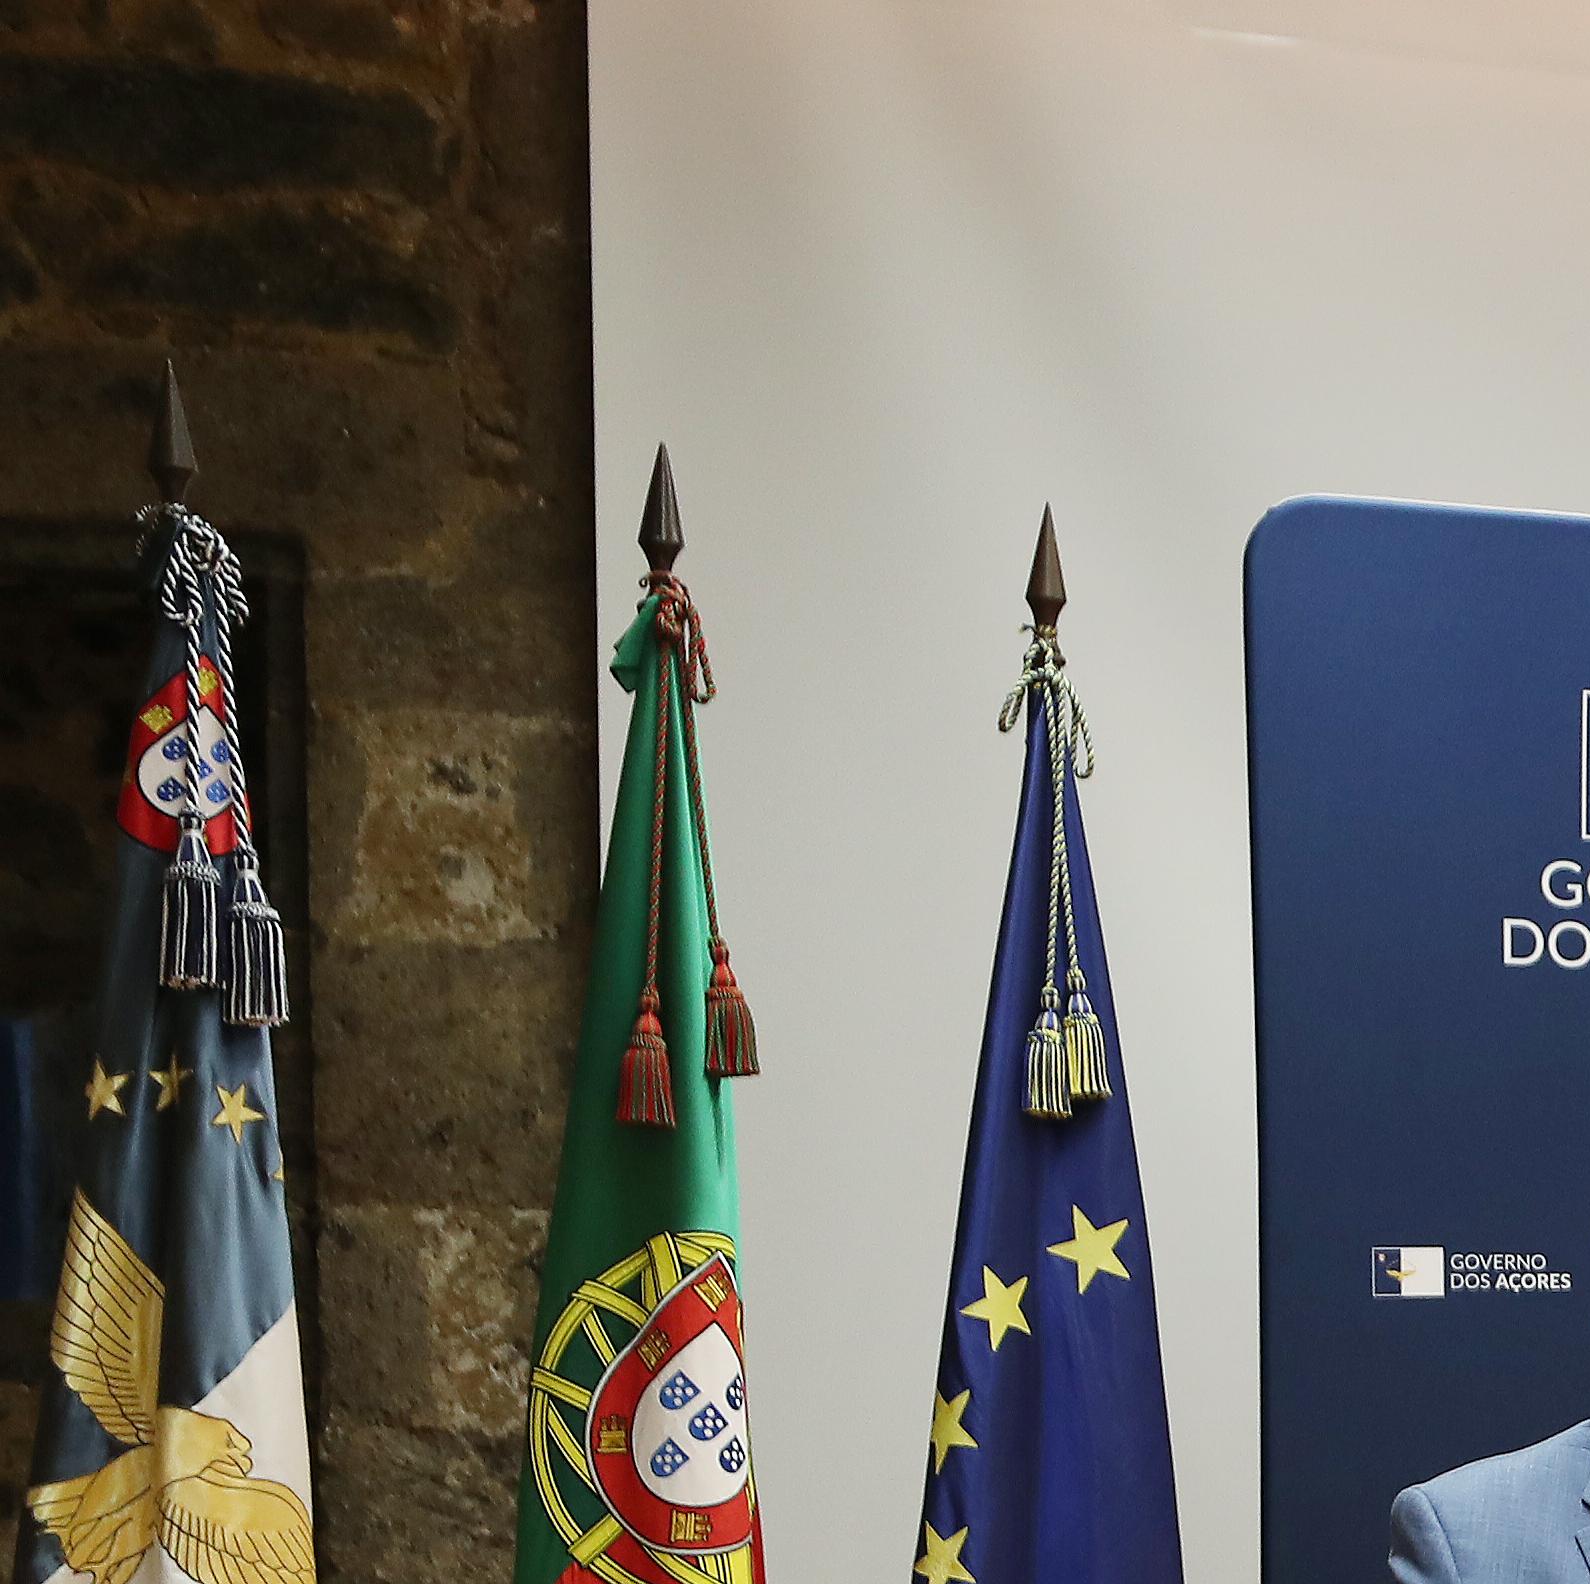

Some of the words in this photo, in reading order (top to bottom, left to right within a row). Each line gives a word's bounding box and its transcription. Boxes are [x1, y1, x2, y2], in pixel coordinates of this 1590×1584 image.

[1450, 1253, 1547, 1271] GOVERNO
[1450, 1272, 1491, 1290] DOS
[1495, 1272, 1572, 1293] AÇORES
